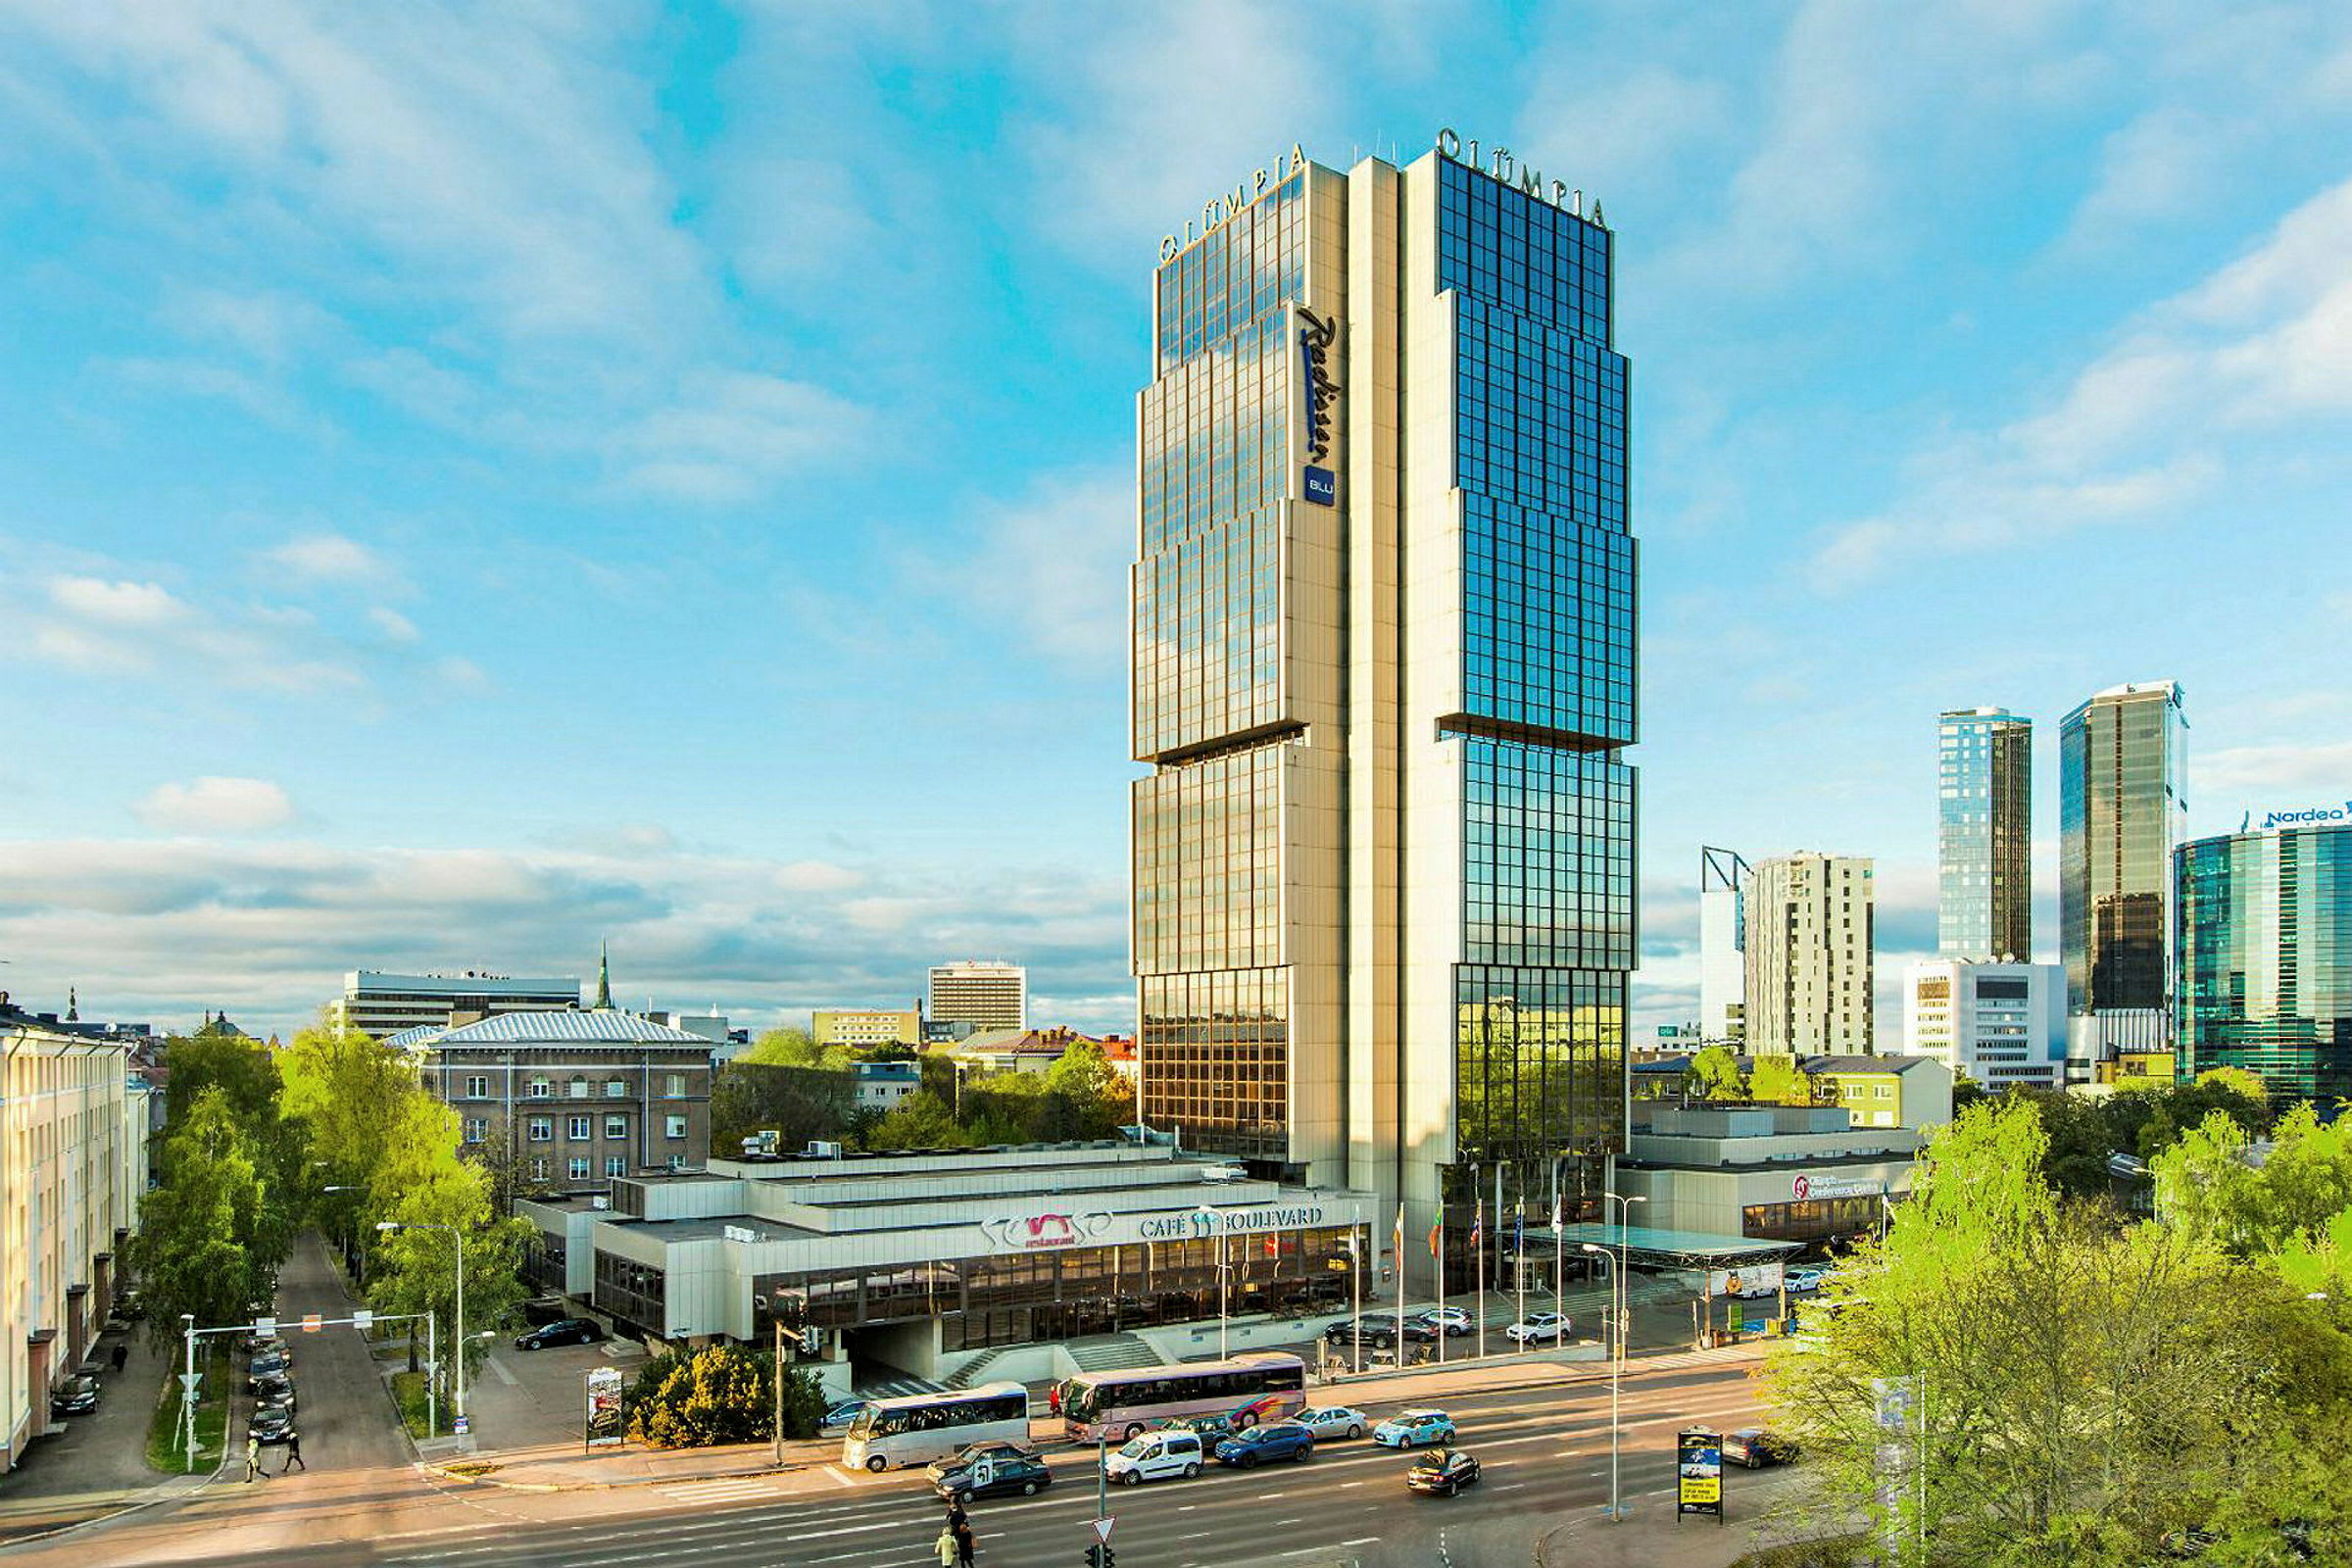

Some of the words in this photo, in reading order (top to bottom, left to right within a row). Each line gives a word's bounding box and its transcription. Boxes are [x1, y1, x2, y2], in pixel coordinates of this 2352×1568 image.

[1159, 141, 1306, 266] OLÜMPIA
[1437, 127, 1606, 228] OLÜMPIA
[1297, 307, 1342, 464] Radisson
[1309, 478, 1334, 495] BLU
[2267, 808, 2344, 825] Nordea
[1141, 1213, 1187, 1238] CAFÉ
